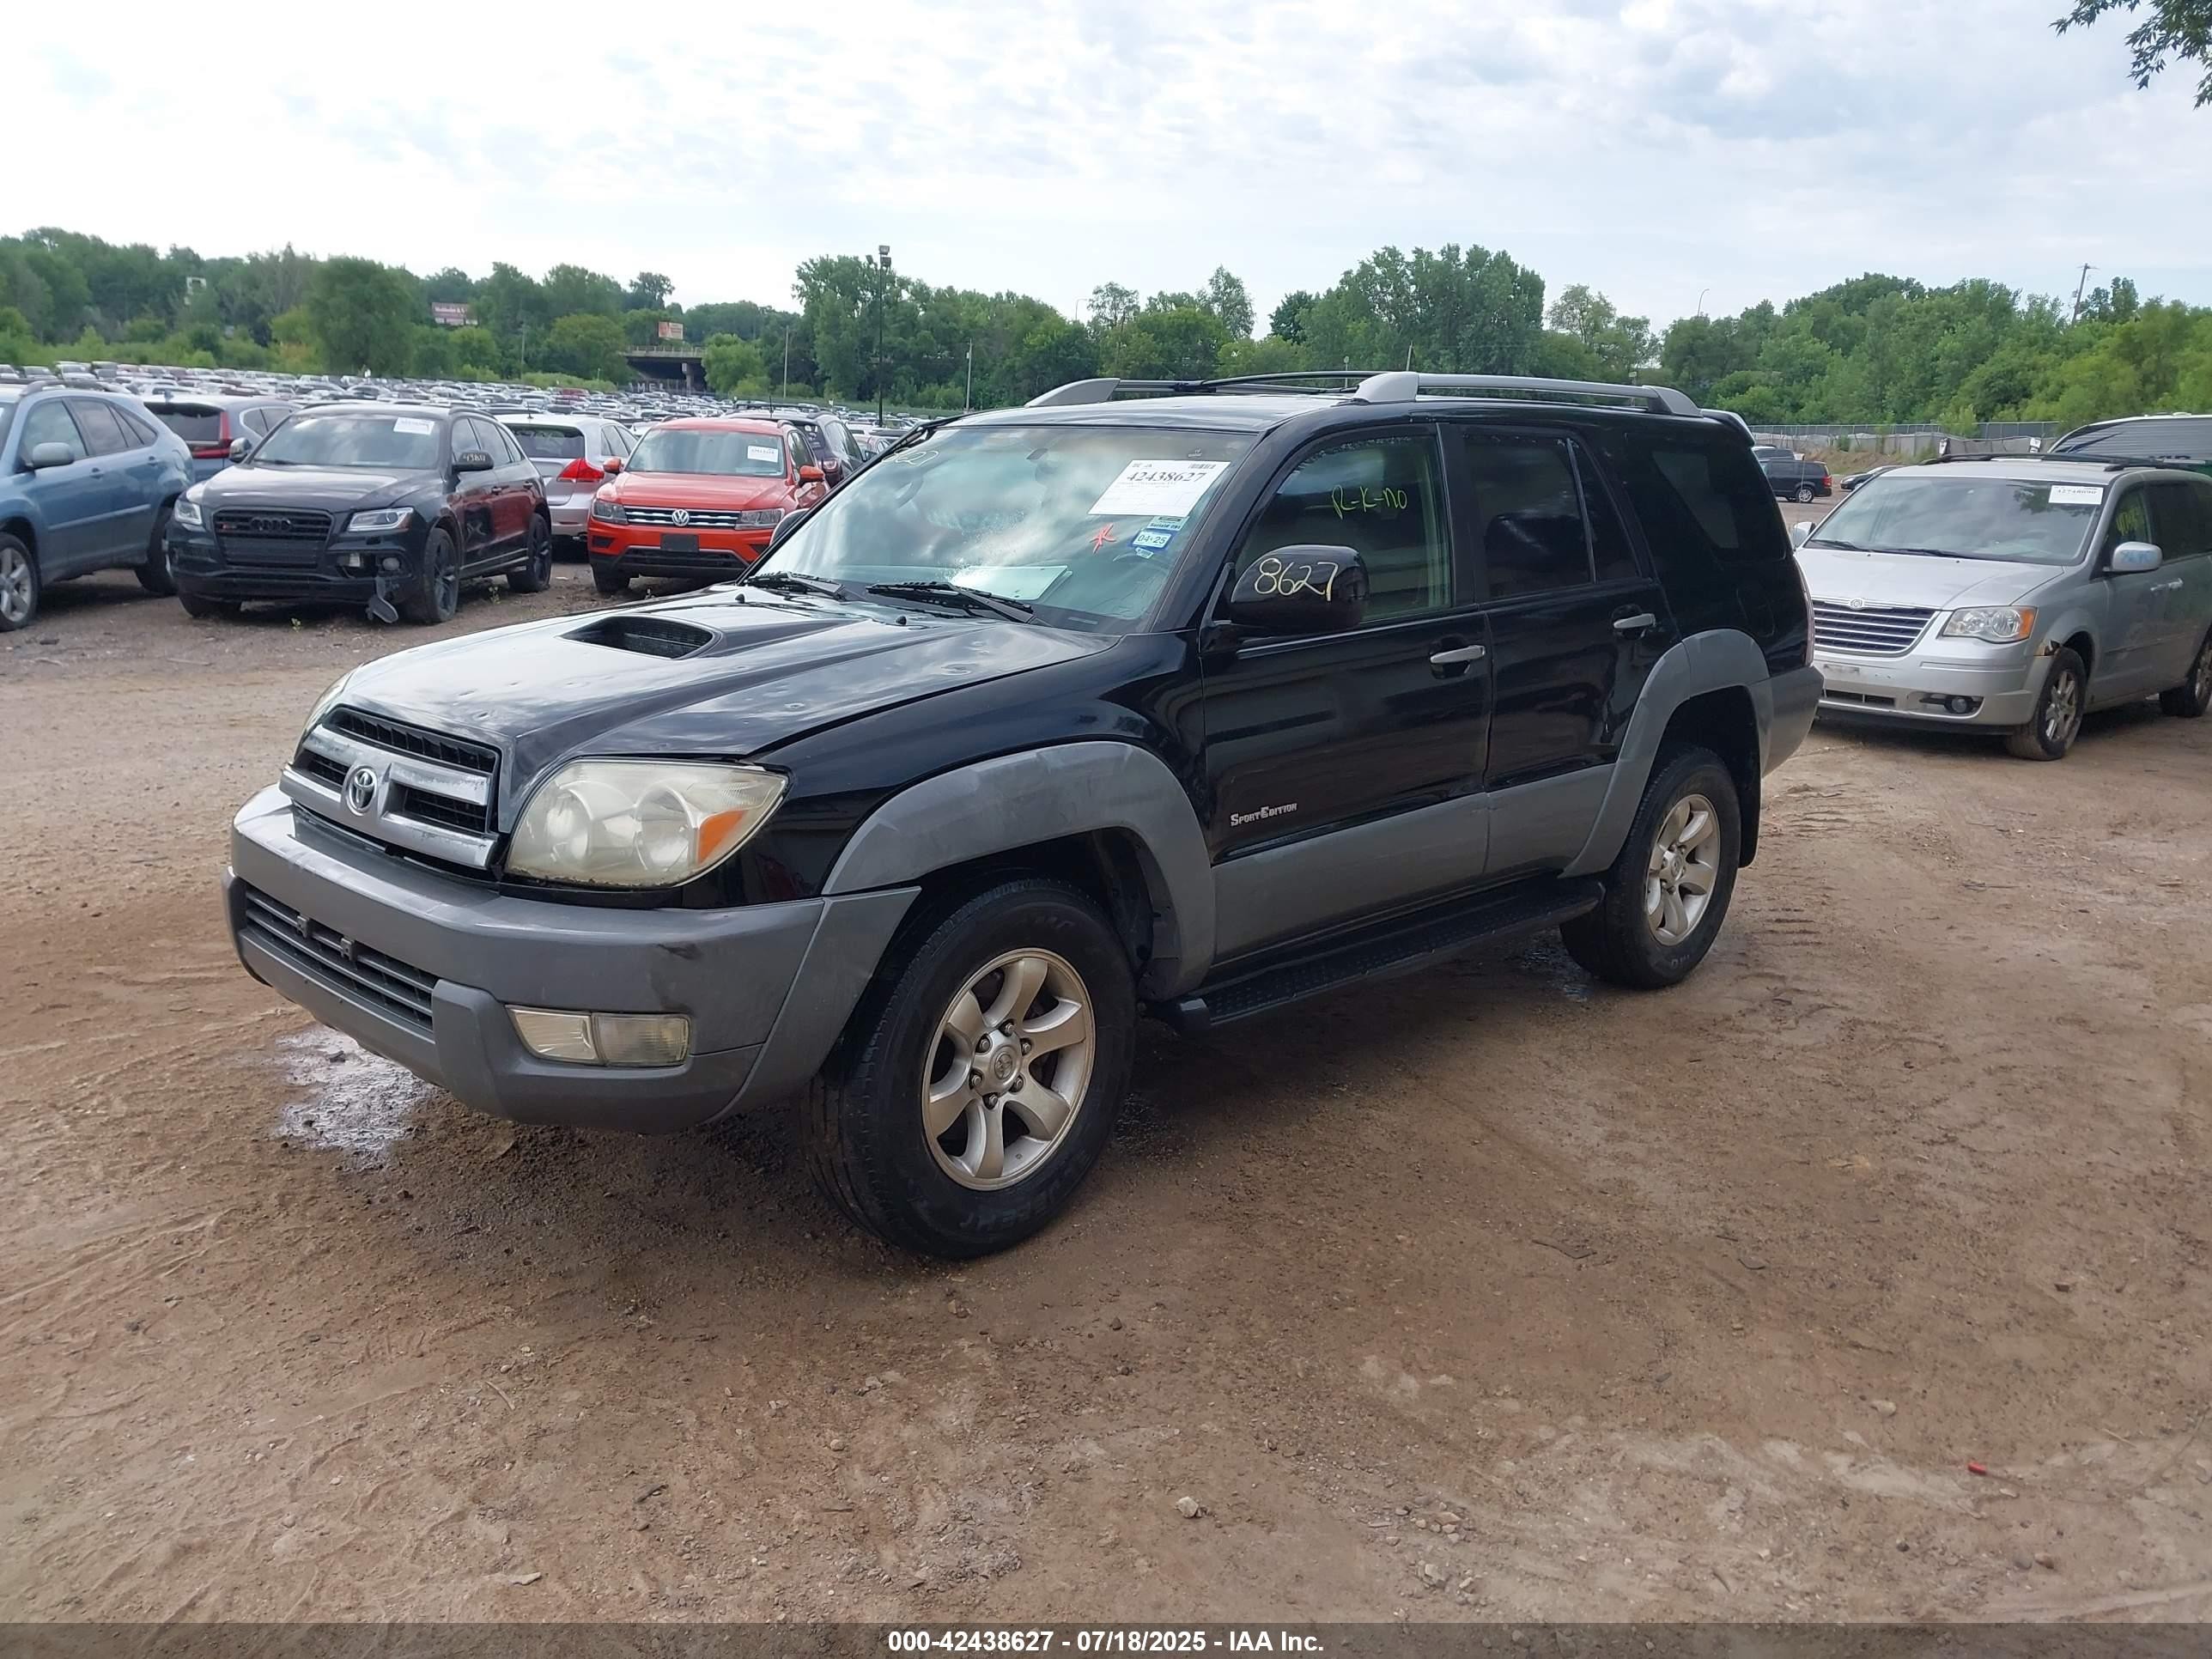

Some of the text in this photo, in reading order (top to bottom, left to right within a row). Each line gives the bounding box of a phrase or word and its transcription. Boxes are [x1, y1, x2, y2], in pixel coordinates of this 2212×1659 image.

[1127, 471, 1207, 483] 42438627
[1153, 536, 1167, 544] 25
[1255, 558, 1339, 601] 8627
